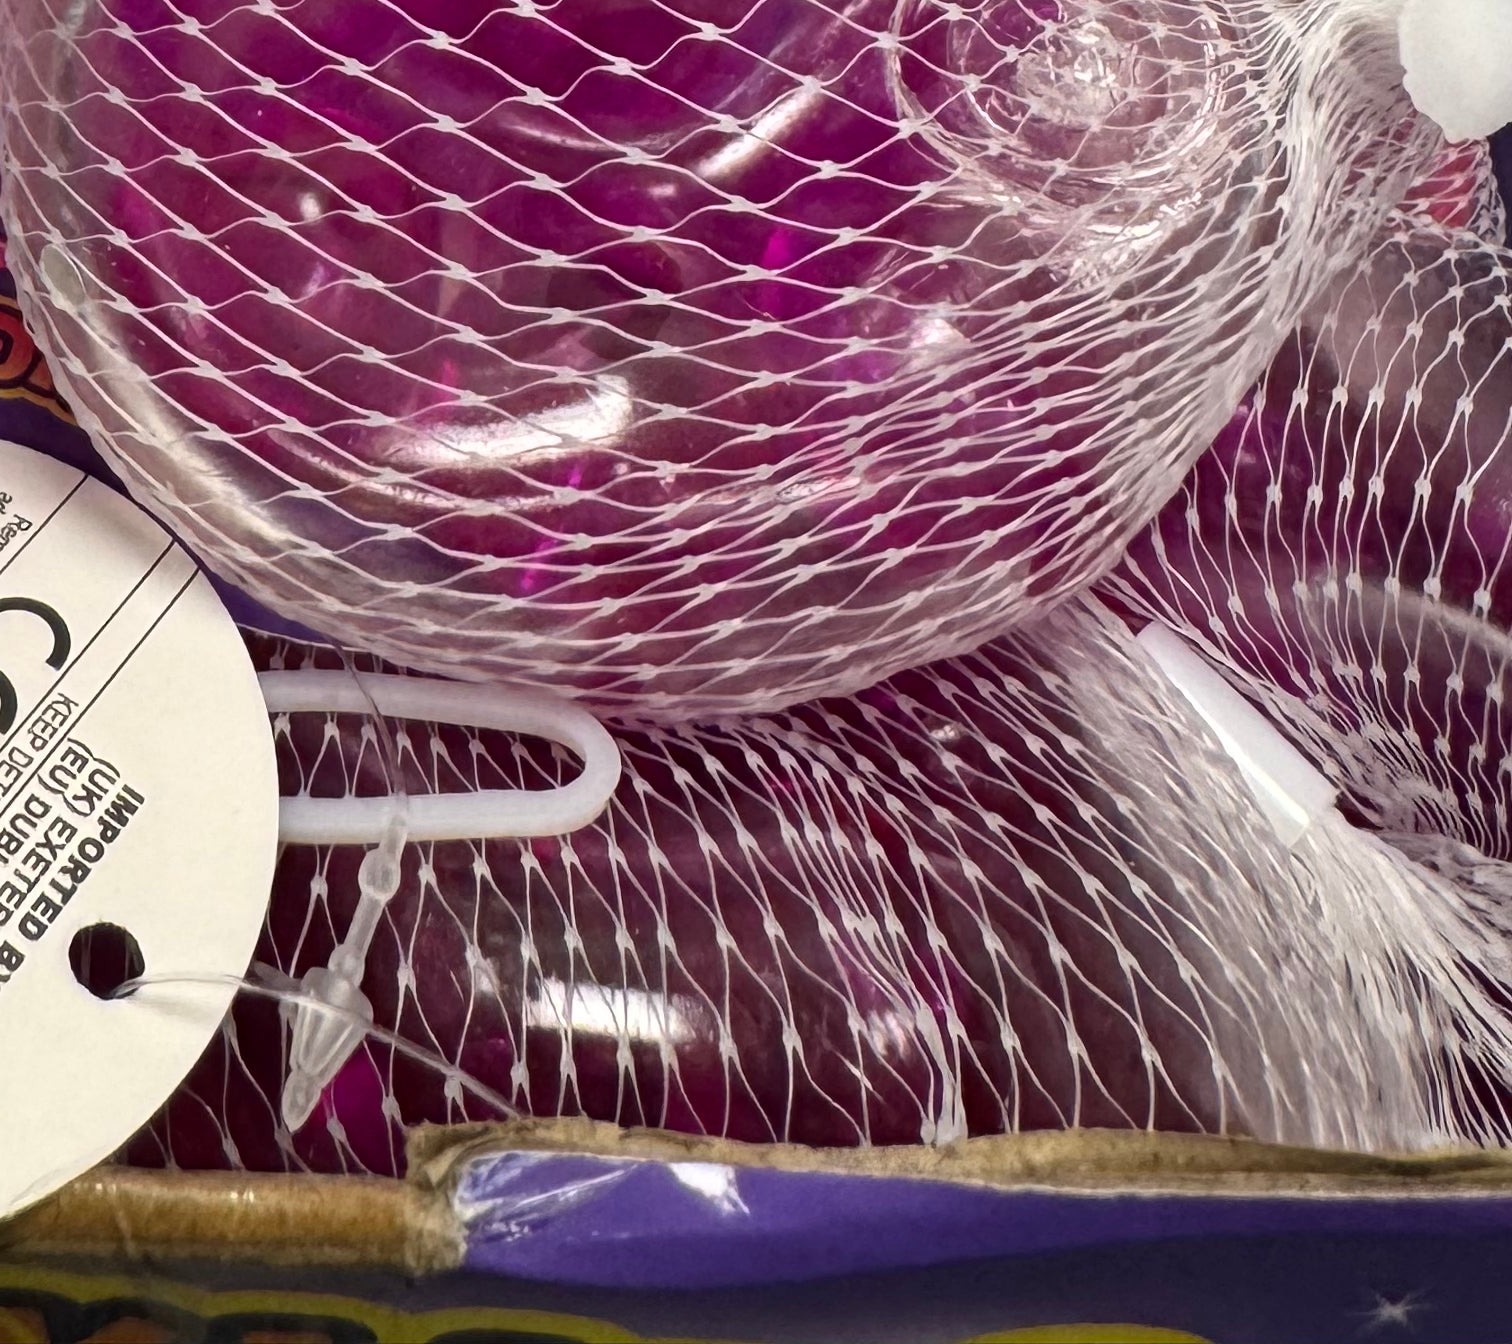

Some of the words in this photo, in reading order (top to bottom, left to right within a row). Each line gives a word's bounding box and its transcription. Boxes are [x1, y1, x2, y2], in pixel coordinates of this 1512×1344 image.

[26, 691, 79, 752] KEEP
[36, 736, 97, 798] (EU)
[60, 755, 121, 817] (UK)
[4, 783, 145, 941] IMPORTED
